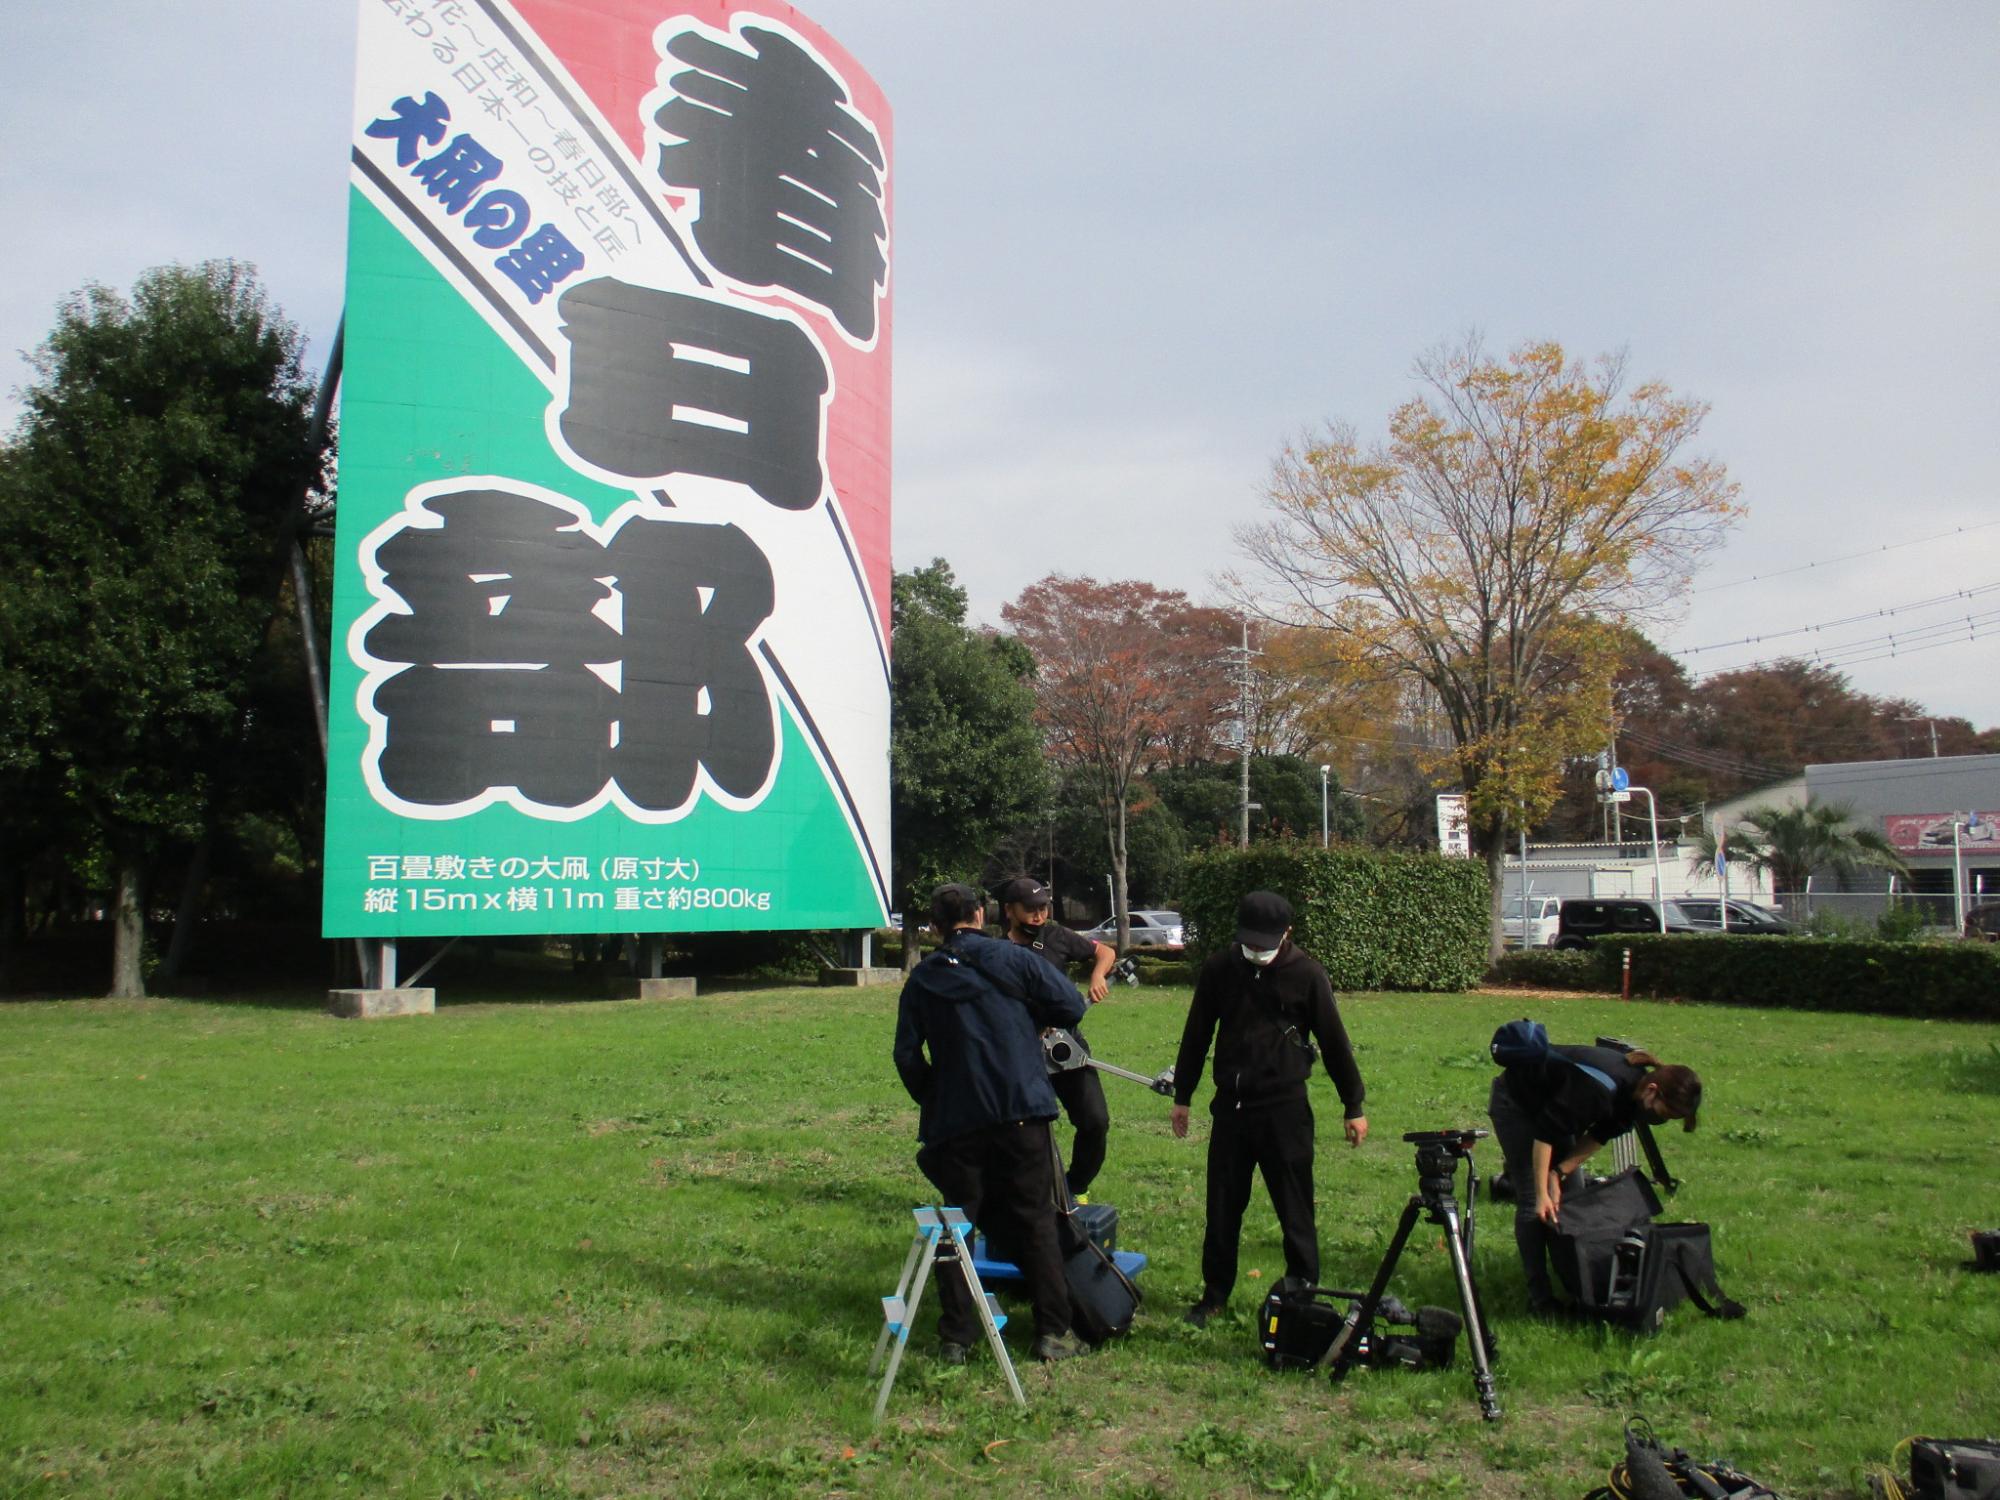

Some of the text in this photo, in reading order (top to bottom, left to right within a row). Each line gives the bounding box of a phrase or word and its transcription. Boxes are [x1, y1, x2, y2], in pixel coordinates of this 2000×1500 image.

[364, 90, 586, 305] 大凧の里
[364, 26, 886, 810] 春日部
